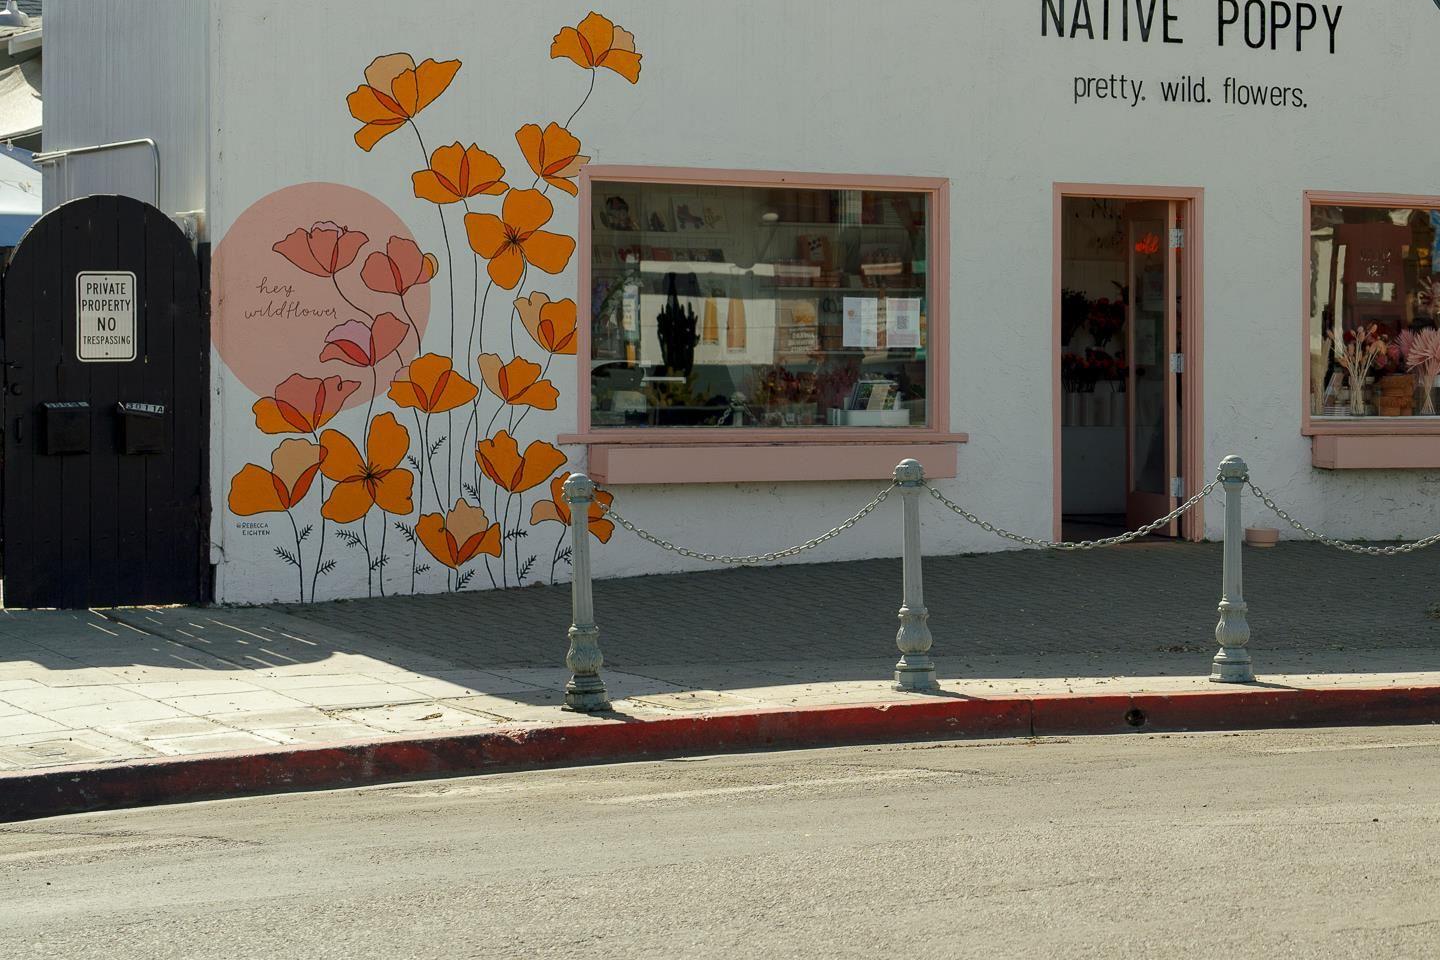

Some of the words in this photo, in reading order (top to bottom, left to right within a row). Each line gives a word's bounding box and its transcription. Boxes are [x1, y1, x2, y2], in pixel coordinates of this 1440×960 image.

[1074, 74, 1146, 107] pretty.
[1160, 75, 1212, 104] wild.
[1223, 77, 1308, 108] flowers.
[87, 283, 126, 295] PRIVATE
[256, 277, 295, 297] hey
[82, 300, 131, 311] PROPERTY
[245, 301, 338, 320] wildflower
[98, 318, 116, 331] NO
[83, 336, 131, 344] TRESPASSING
